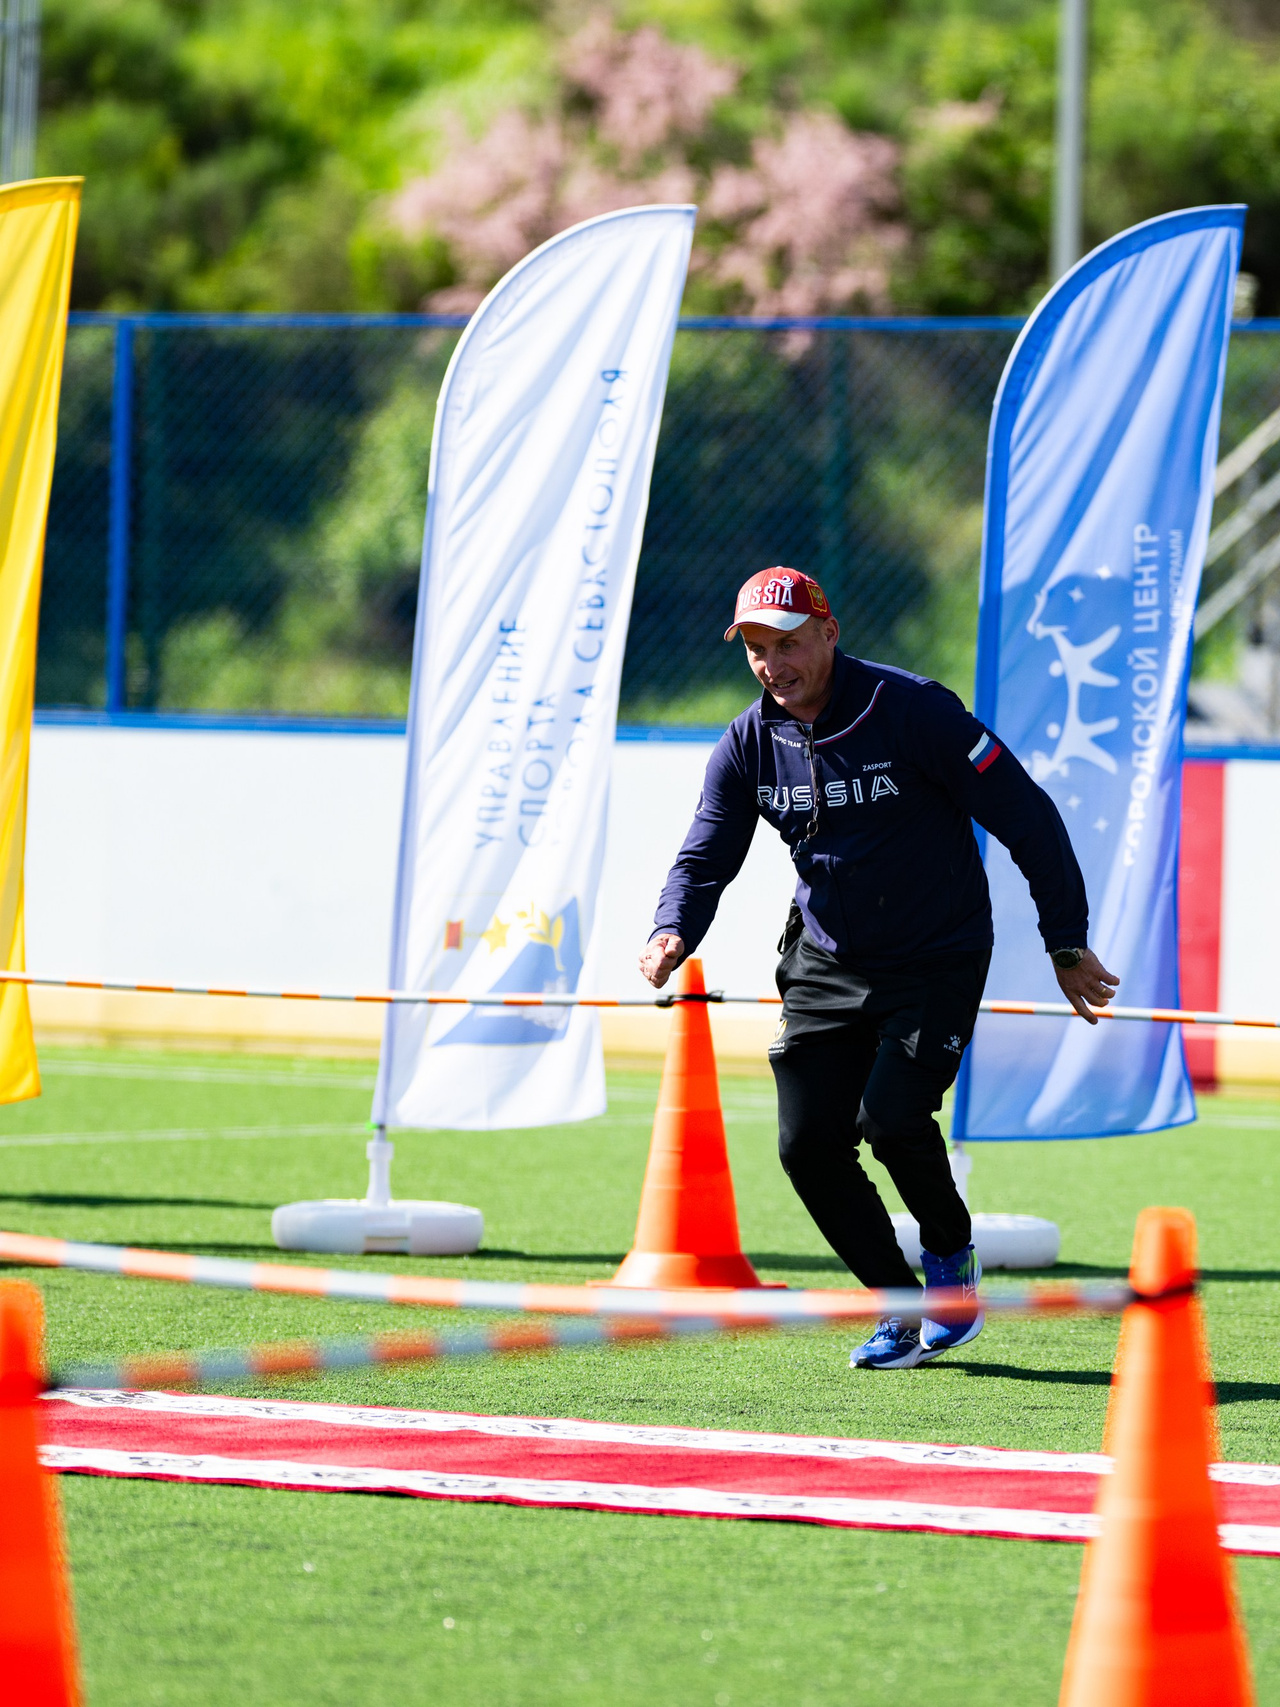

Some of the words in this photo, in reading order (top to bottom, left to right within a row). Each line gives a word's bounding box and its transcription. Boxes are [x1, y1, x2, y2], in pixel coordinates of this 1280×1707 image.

[1132, 523, 1163, 633] ЦЕНТР
[474, 618, 526, 849] УПРАВЛЕНИЕ
[518, 692, 557, 848] СПОРТА
[771, 732, 787, 745] YMPIC
[862, 761, 893, 772] ZASPORT
[757, 774, 900, 812] RUSSIA
